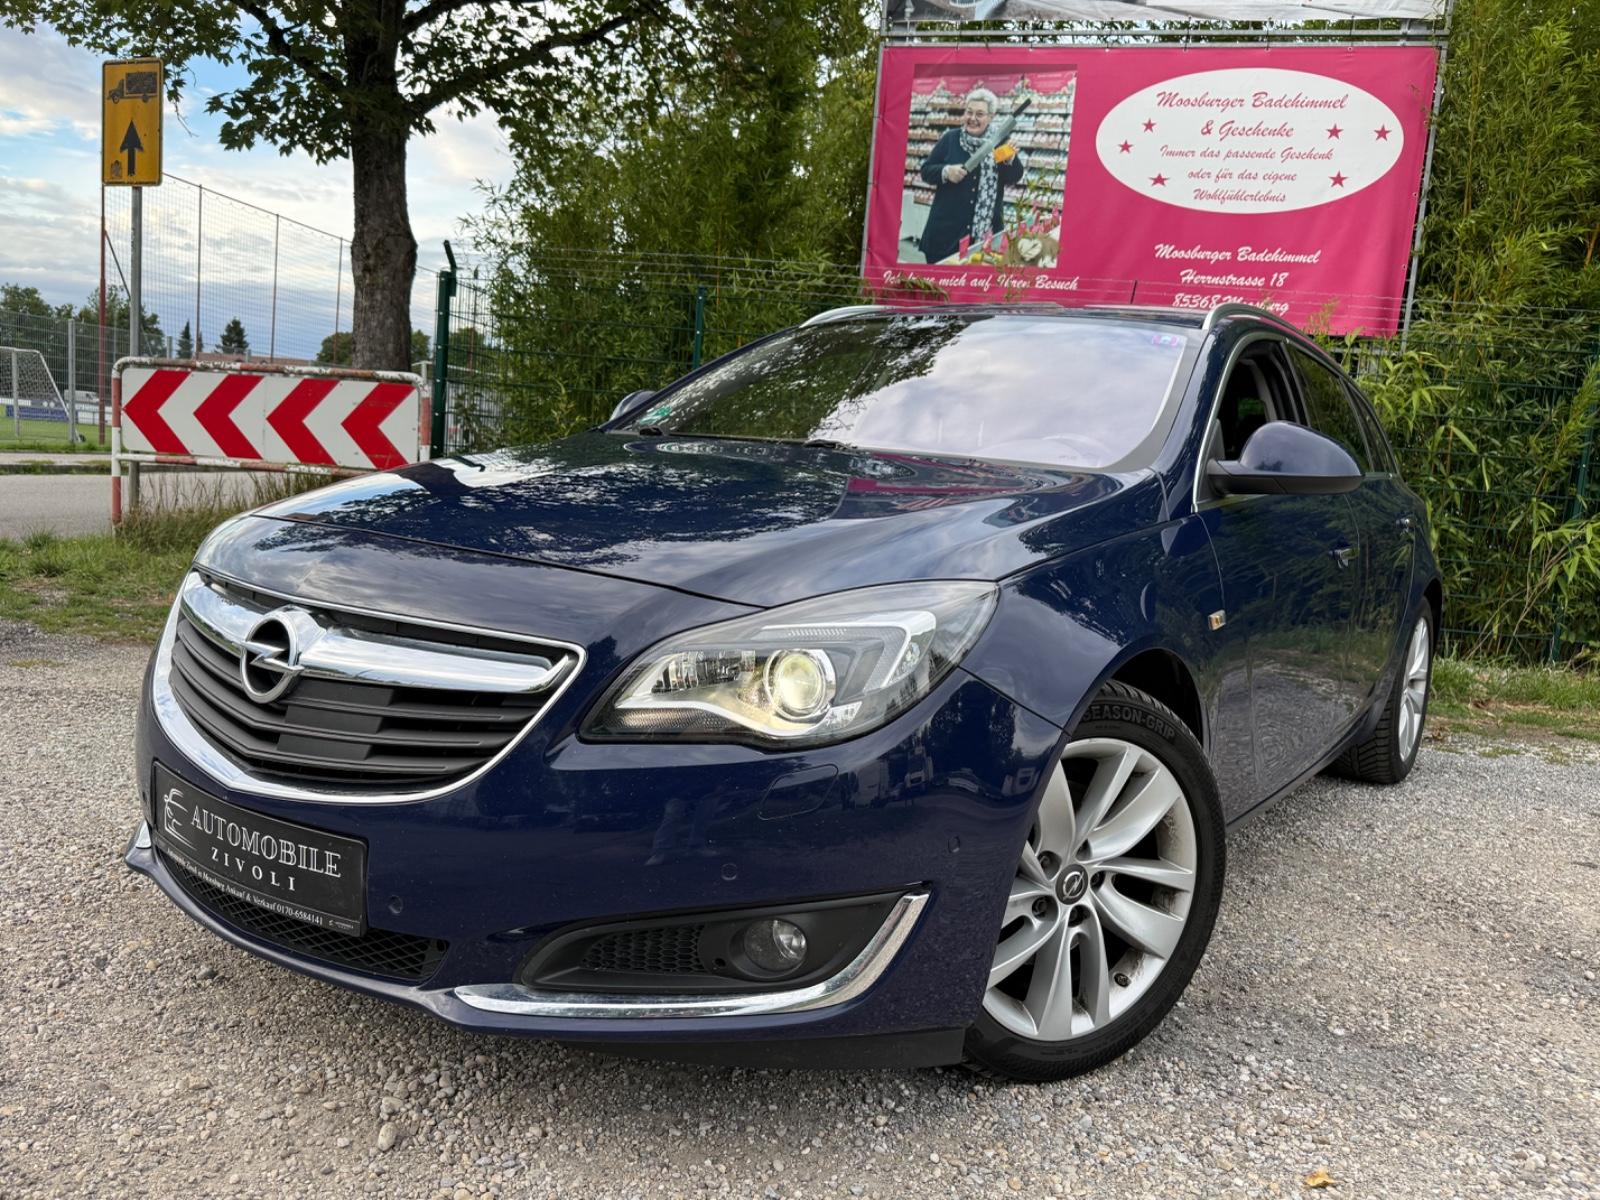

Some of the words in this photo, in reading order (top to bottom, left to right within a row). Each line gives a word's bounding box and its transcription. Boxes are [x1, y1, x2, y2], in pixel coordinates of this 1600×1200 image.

[1156, 91, 1246, 113] Moosburger
[1251, 91, 1349, 110] Badehimmel
[1200, 119, 1215, 136] &
[1218, 120, 1295, 142] Geschenke
[1159, 144, 1196, 158] Immer
[1199, 146, 1220, 158] das
[1223, 146, 1276, 160] passende
[1280, 146, 1335, 164] Geschenk
[1187, 168, 1211, 180] oder
[1214, 168, 1234, 183] für
[1237, 169, 1258, 181] das
[1262, 171, 1298, 185] eigene
[1193, 187, 1286, 205] Wohlfühlerlebnis
[1154, 243, 1232, 265] Moosburger
[1237, 246, 1322, 265] Badehimmel
[938, 273, 966, 287] mich
[970, 274, 992, 292] auf
[1034, 274, 1080, 291] Besuch
[1179, 269, 1265, 287] Herrnstrasse
[1270, 272, 1290, 288] 18
[1172, 292, 1222, 309] 85368
[190, 805, 343, 879] AUTOMOBILE
